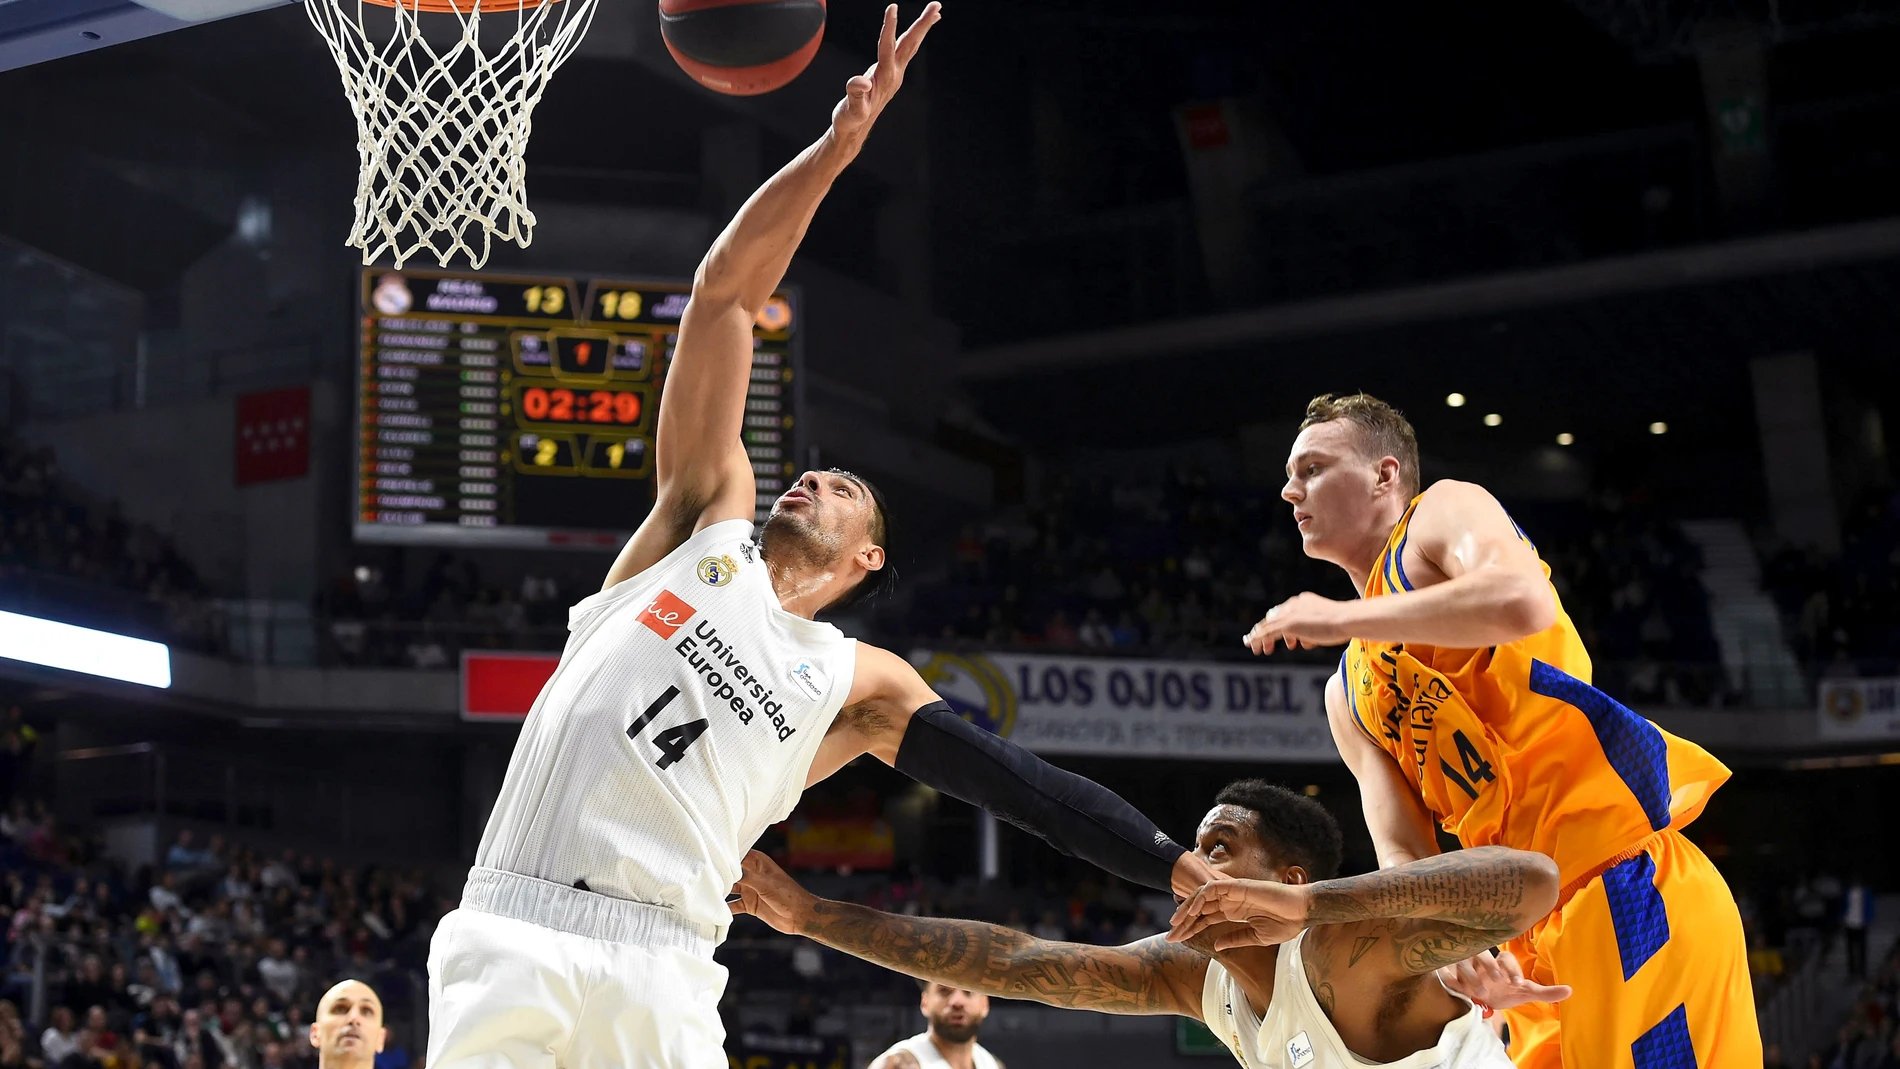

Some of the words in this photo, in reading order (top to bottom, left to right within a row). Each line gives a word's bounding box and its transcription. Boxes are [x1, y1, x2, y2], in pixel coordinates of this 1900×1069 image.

[523, 285, 566, 314] 13
[600, 290, 643, 320] 18
[573, 341, 591, 366] 1
[523, 387, 641, 424] 02:29
[534, 438, 558, 466] 2
[606, 442, 624, 469] 1
[647, 600, 684, 627] ue
[675, 636, 755, 726] Europea
[695, 619, 797, 743] Universidad
[1018, 664, 1096, 706] LOS
[1107, 667, 1213, 712] OJOS
[1226, 673, 1304, 715] DEL
[625, 684, 710, 771] 14
[1439, 729, 1497, 801] 14
